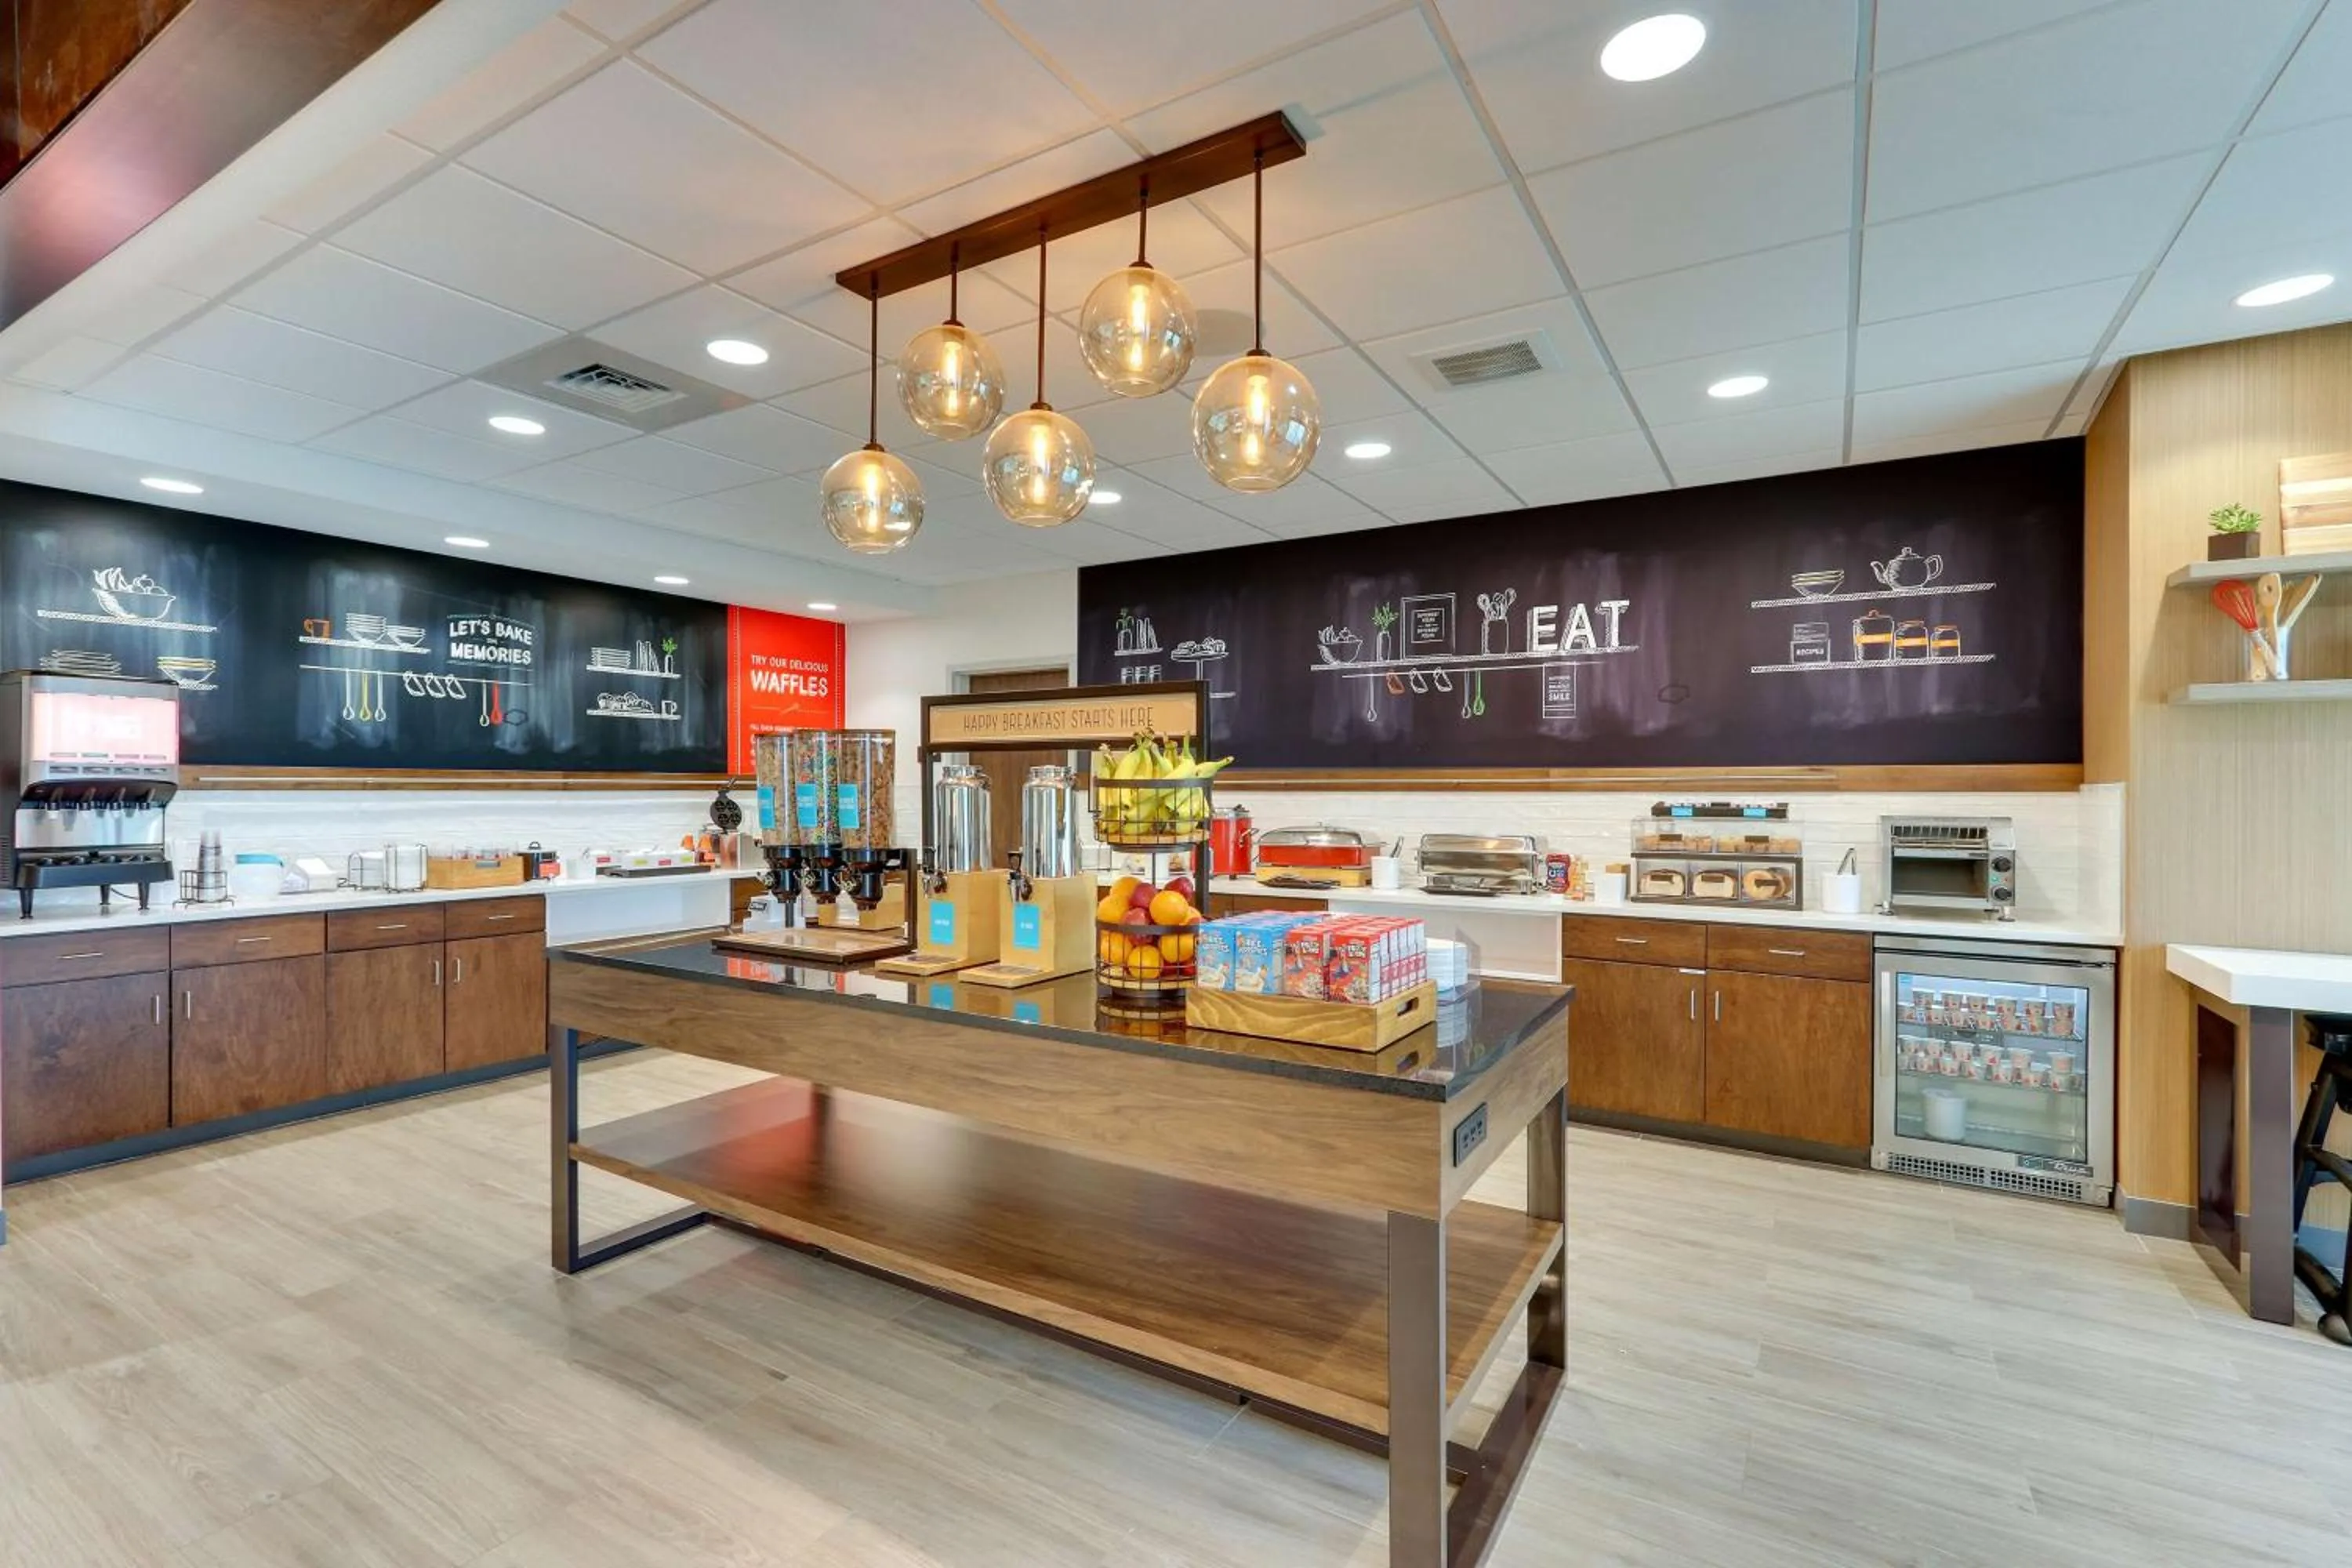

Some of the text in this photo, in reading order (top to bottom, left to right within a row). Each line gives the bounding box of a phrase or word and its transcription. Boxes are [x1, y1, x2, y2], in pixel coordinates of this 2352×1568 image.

[449, 620, 532, 645] LET'S BAKE
[1527, 600, 1630, 652] EAT
[451, 642, 532, 665] MEMORIES
[751, 654, 829, 672] TRY OUR DELICIOUS
[750, 670, 829, 698] WAFFLES
[964, 706, 1154, 731] HAPPY BREAKFAST STARTS HERE
